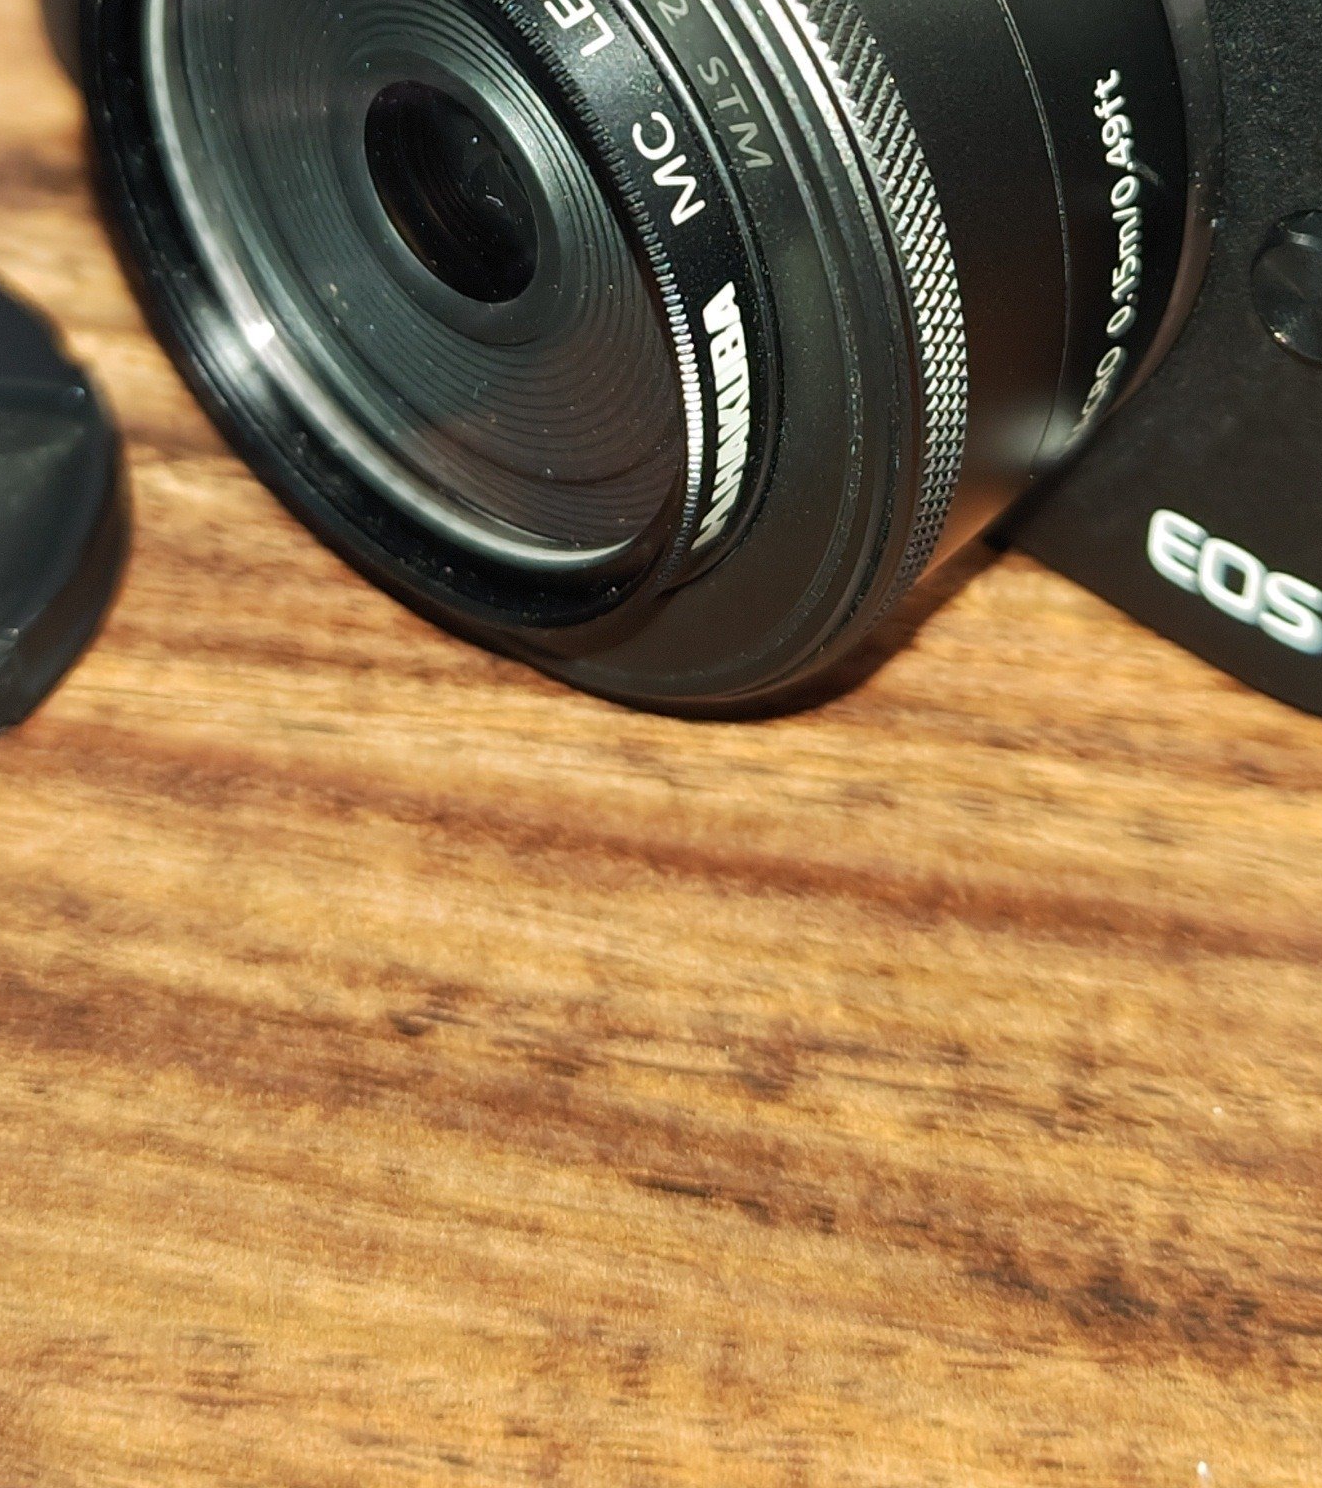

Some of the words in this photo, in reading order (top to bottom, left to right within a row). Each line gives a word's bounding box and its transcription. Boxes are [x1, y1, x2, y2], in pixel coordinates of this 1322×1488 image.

[631, 110, 706, 227] MC
[696, 55, 774, 170] STM
[1094, 67, 1141, 339] 0.15m/0.49ft
[703, 281, 750, 503] HAKUBA
